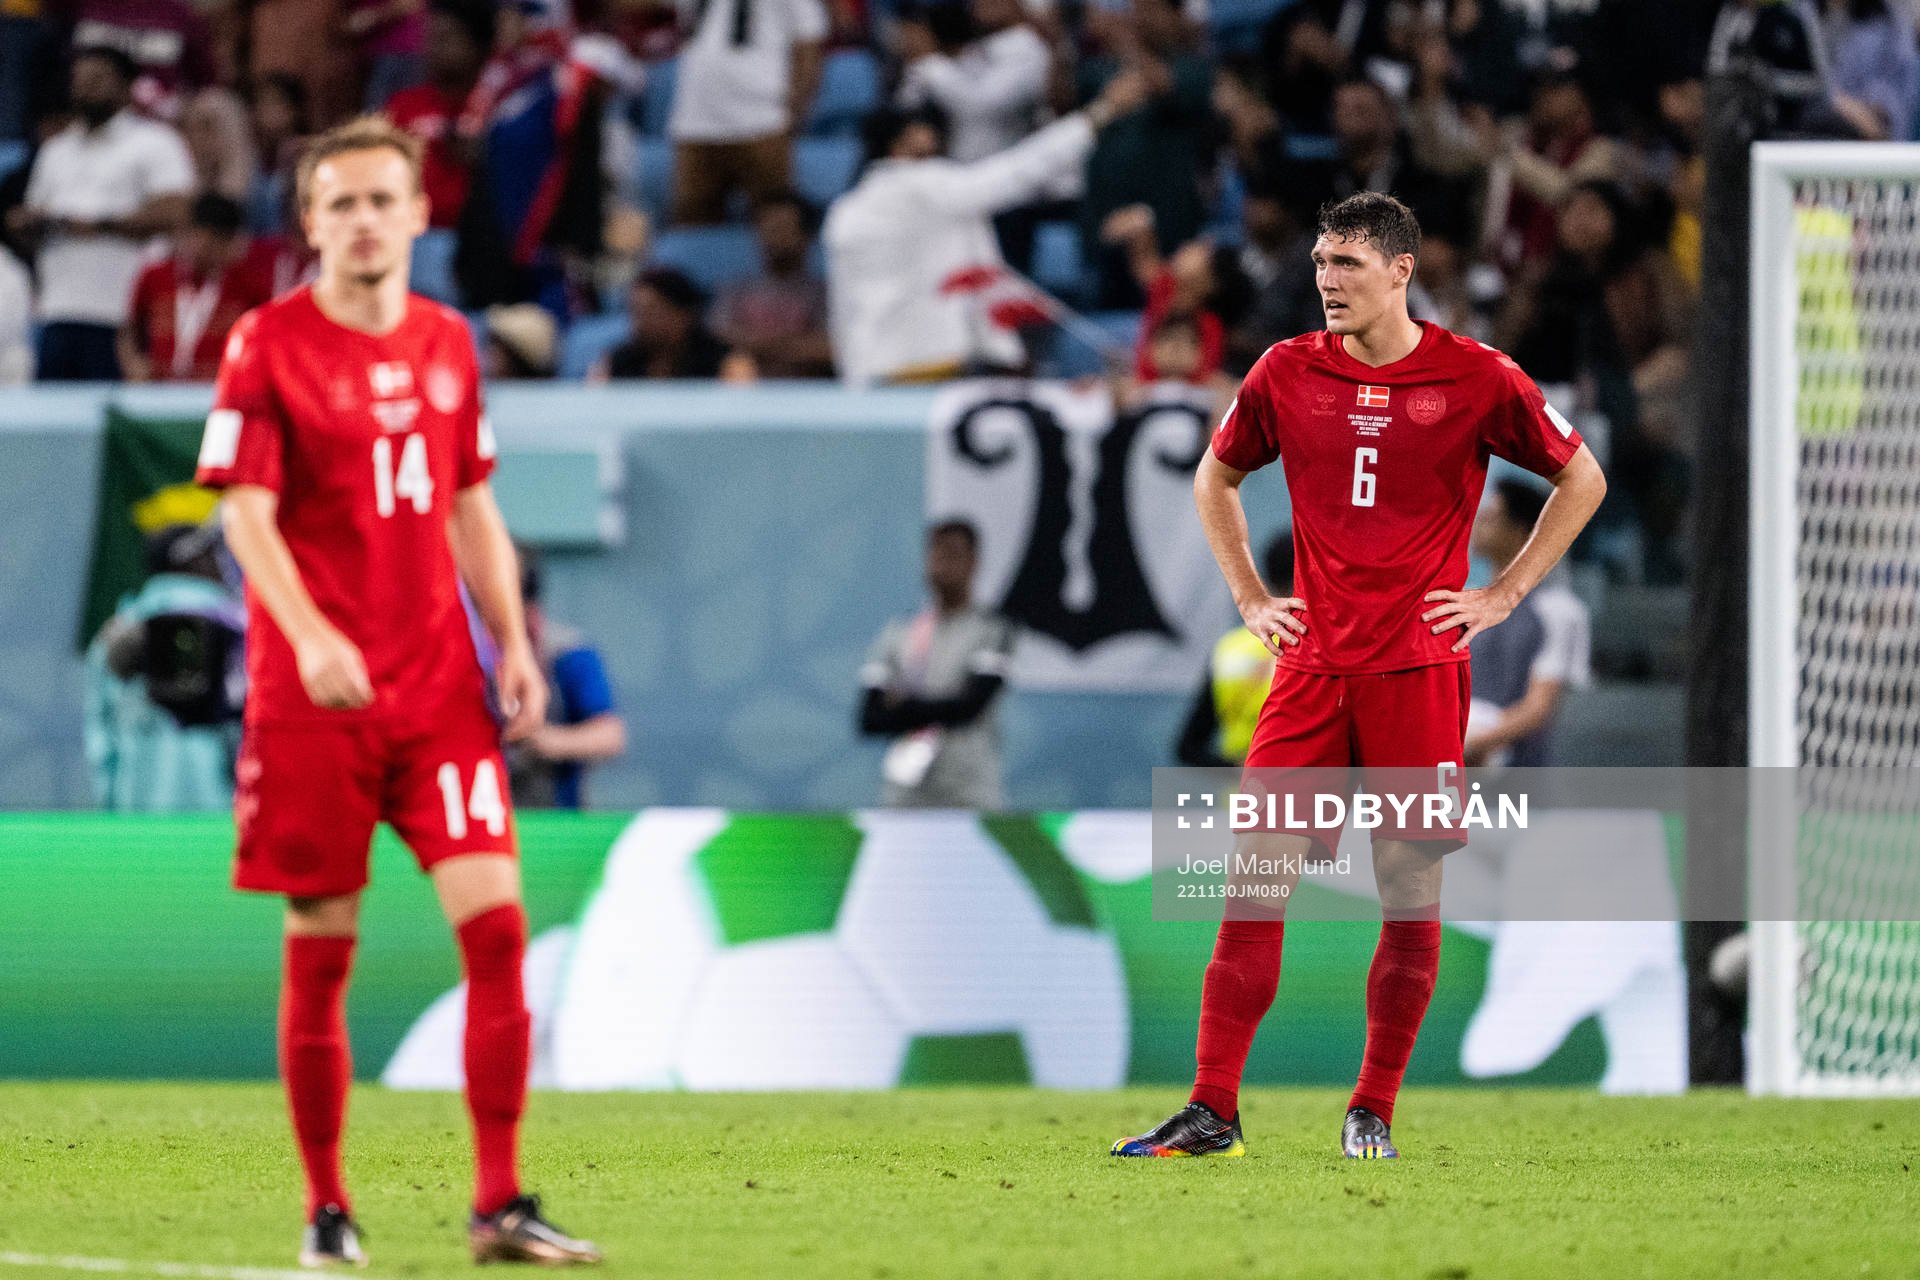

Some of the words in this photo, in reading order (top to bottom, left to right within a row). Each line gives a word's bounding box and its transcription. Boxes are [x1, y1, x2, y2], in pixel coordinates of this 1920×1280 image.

[372, 433, 435, 519] 14
[1351, 447, 1378, 507] 6
[437, 759, 507, 840] 14
